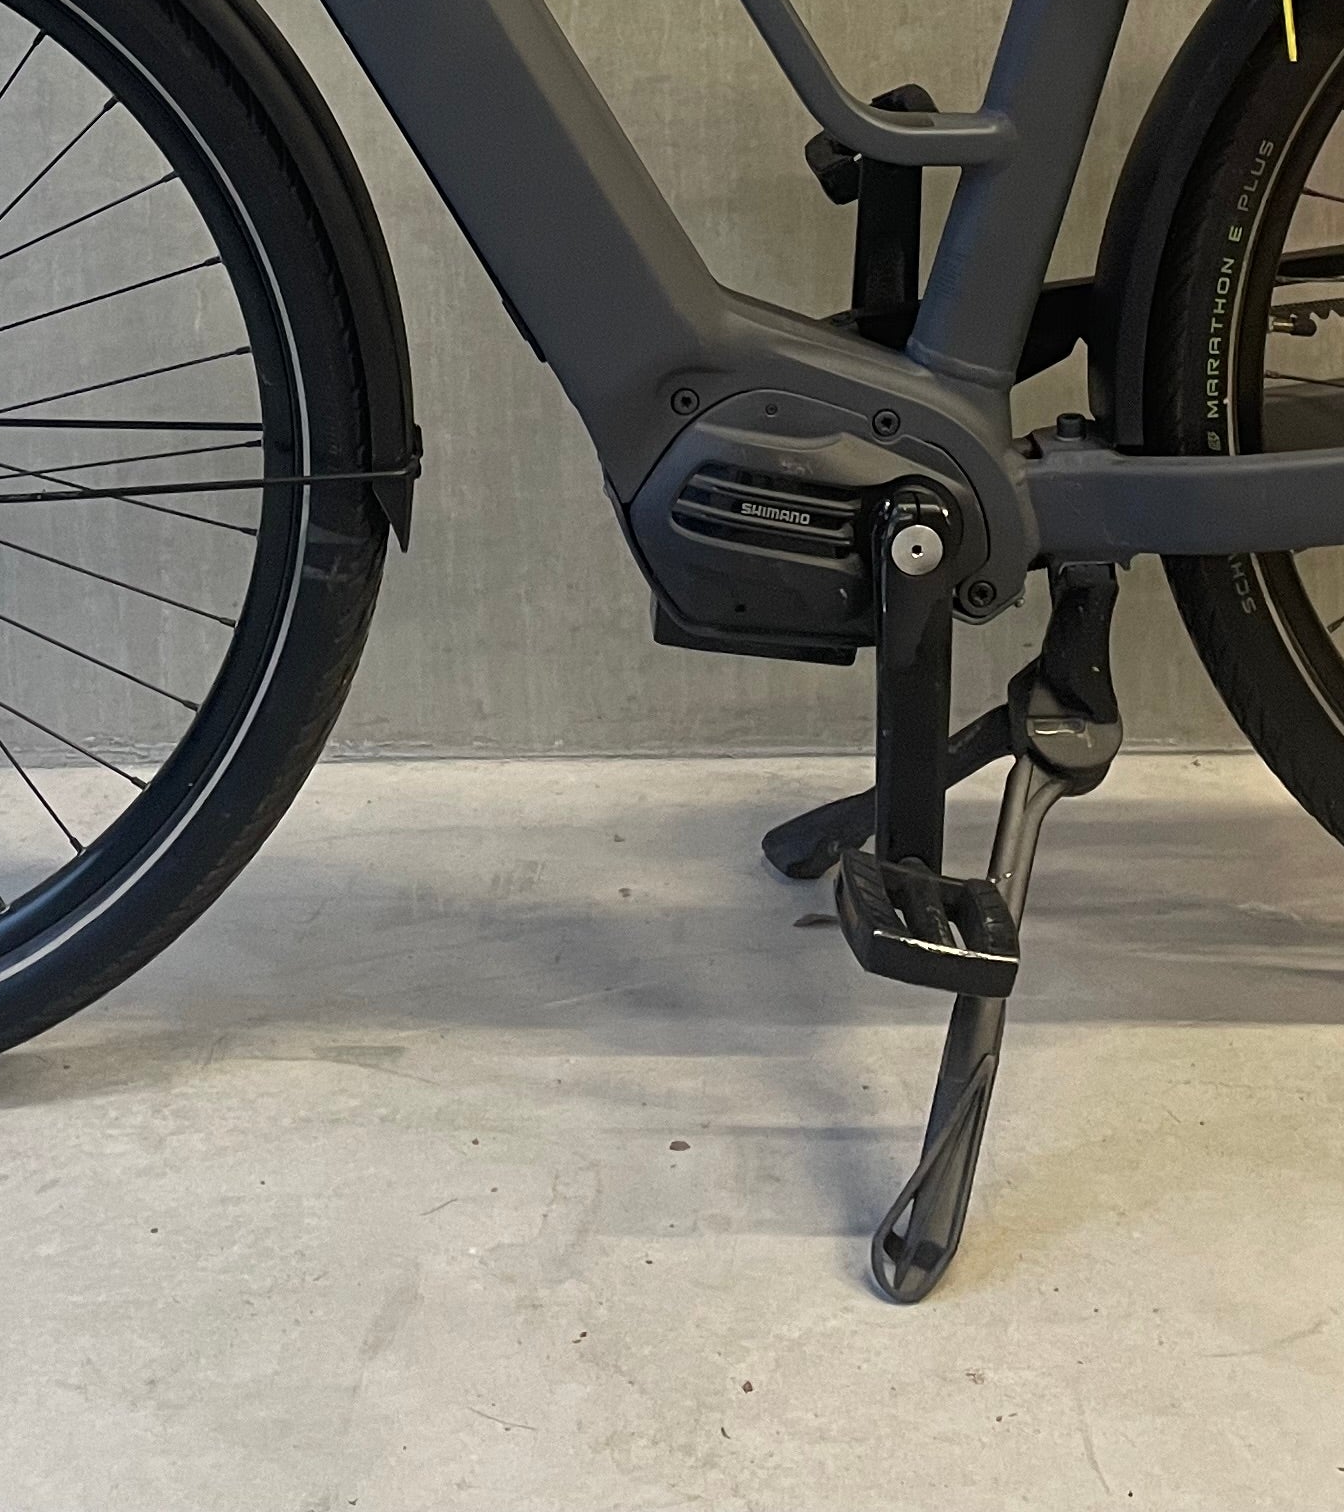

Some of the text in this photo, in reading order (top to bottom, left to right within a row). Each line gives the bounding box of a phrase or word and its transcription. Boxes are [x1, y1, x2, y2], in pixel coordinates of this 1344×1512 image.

[1207, 139, 1275, 419] MARATHON E PLUS
[740, 502, 811, 525] SHIMANO
[1227, 554, 1258, 614] SCH
